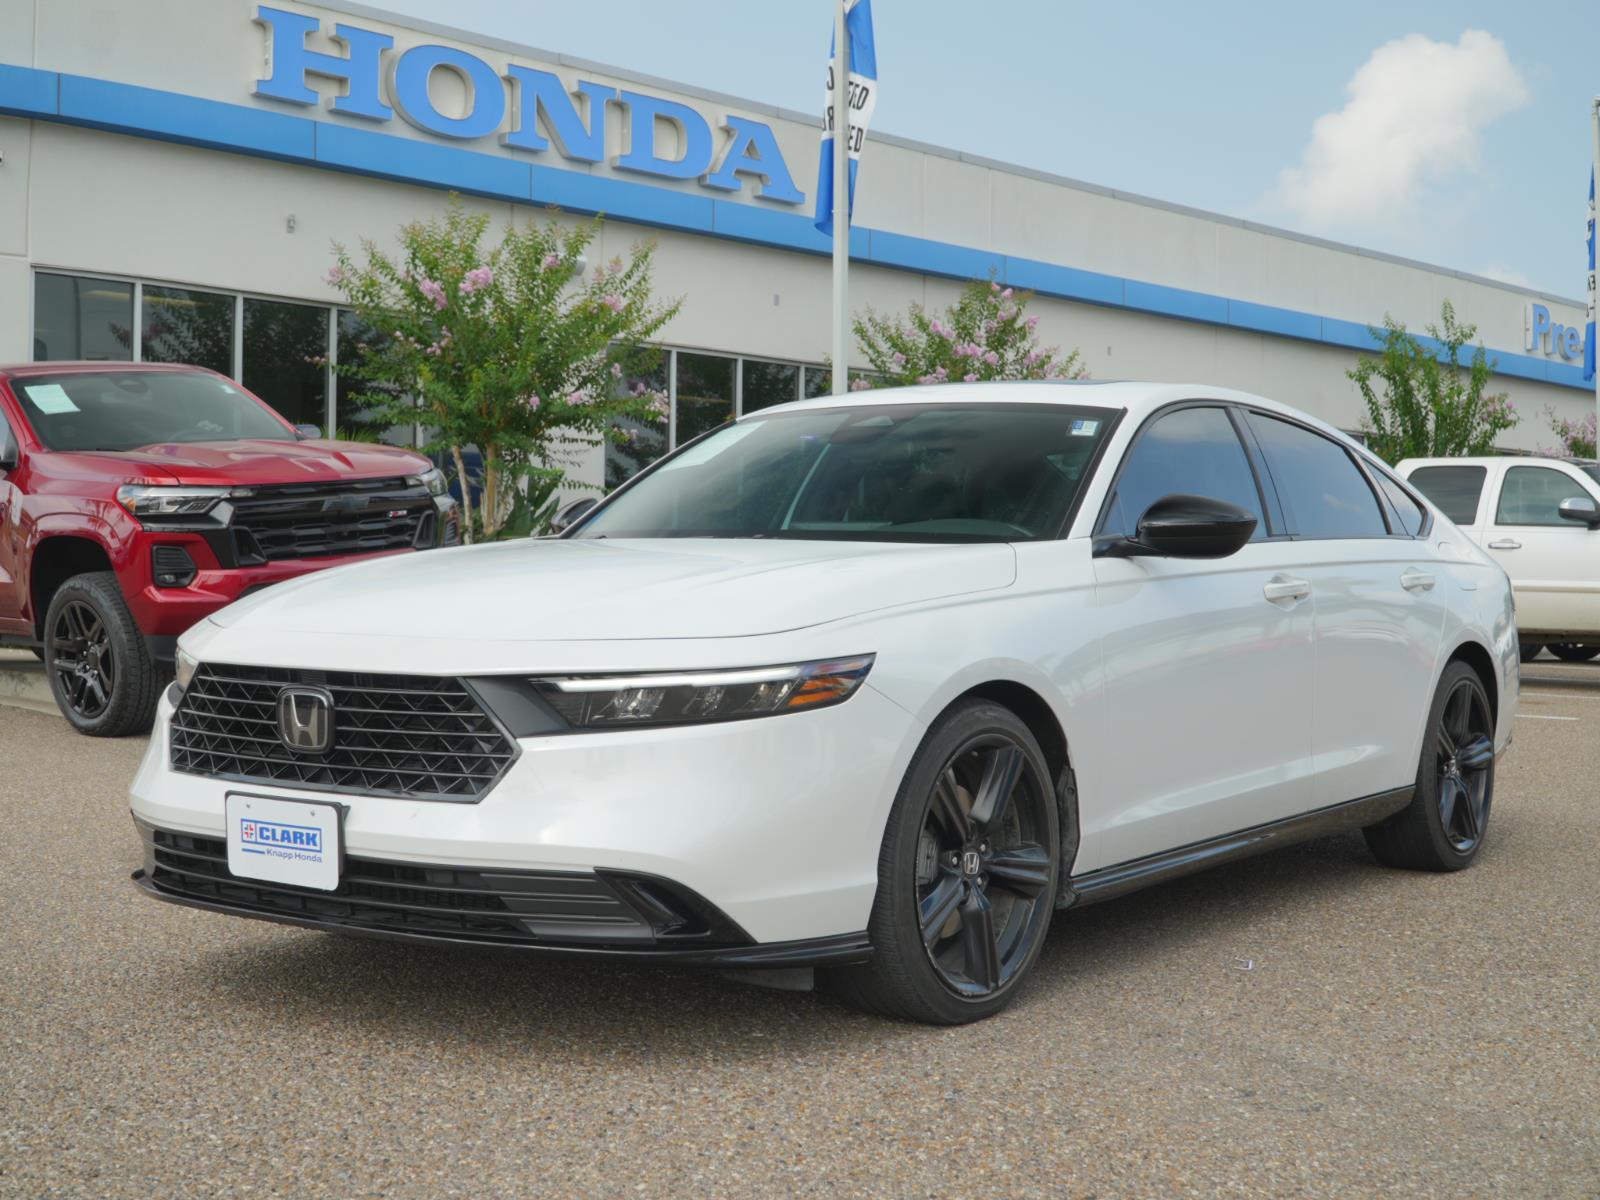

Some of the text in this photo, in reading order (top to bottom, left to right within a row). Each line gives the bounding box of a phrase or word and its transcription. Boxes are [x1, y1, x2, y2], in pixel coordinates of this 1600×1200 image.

[253, 5, 805, 204] HONDA
[1527, 303, 1583, 360] Pre
[259, 826, 318, 847] CLARK
[266, 848, 322, 863] Knapp Honda
